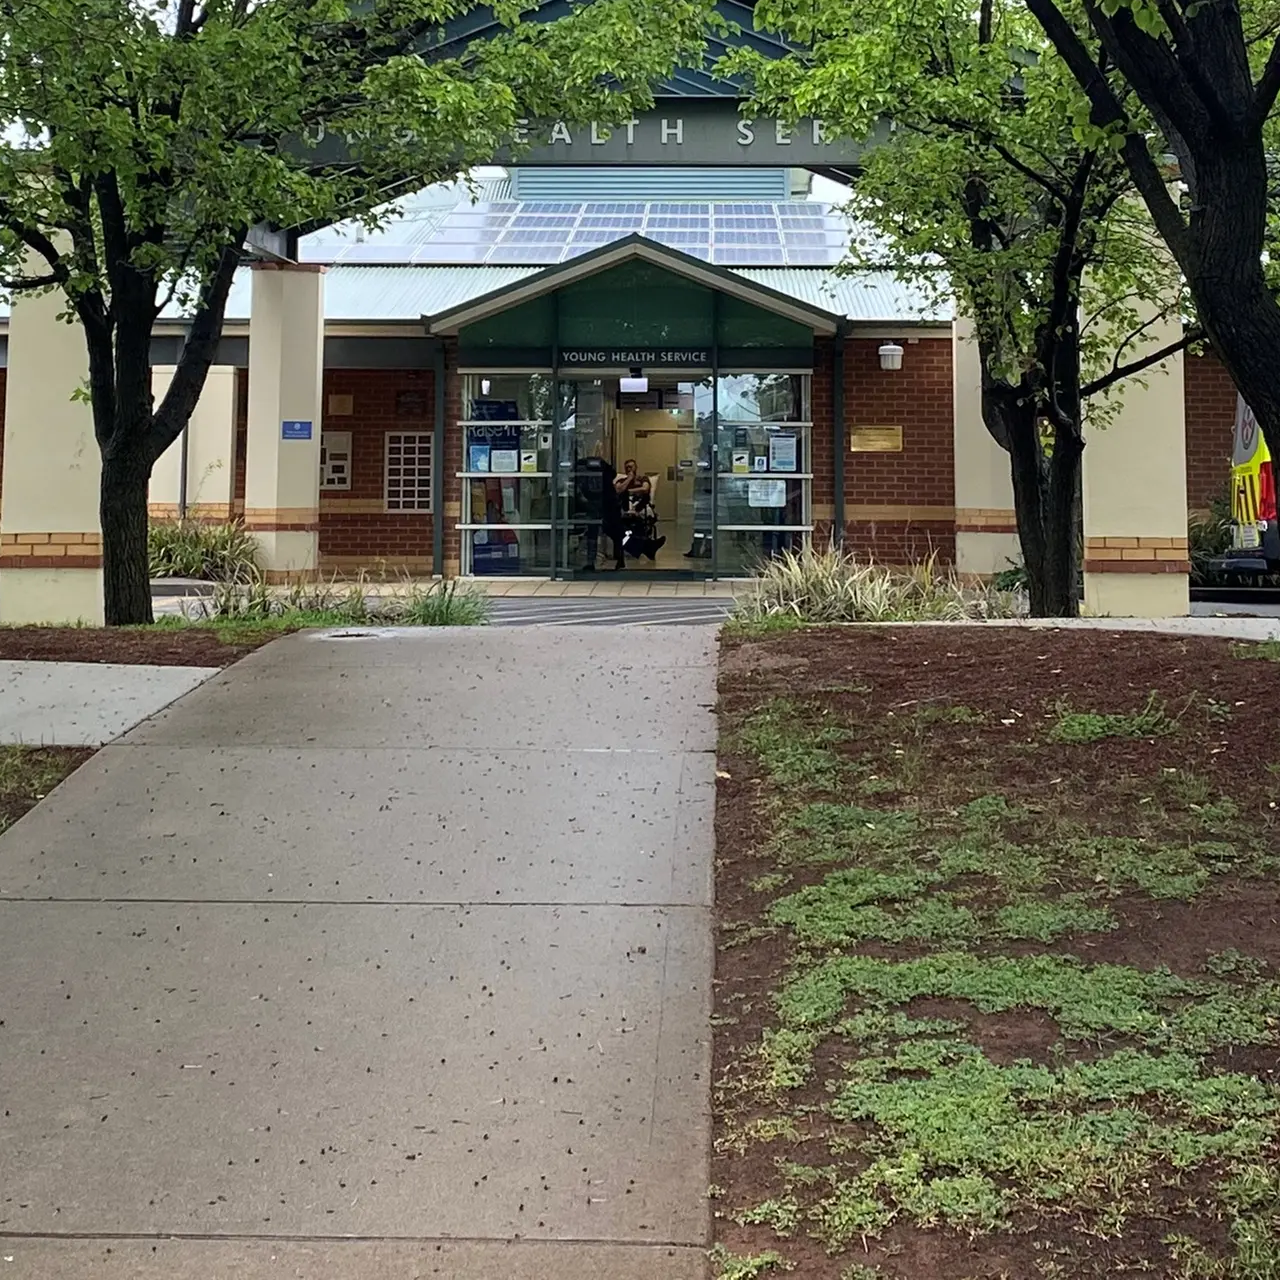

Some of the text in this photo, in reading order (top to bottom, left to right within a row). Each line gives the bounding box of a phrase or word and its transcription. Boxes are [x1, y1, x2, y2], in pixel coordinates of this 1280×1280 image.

[513, 118, 684, 145] EALTH
[562, 351, 707, 362] YOUNG HEALTH SERVICE
